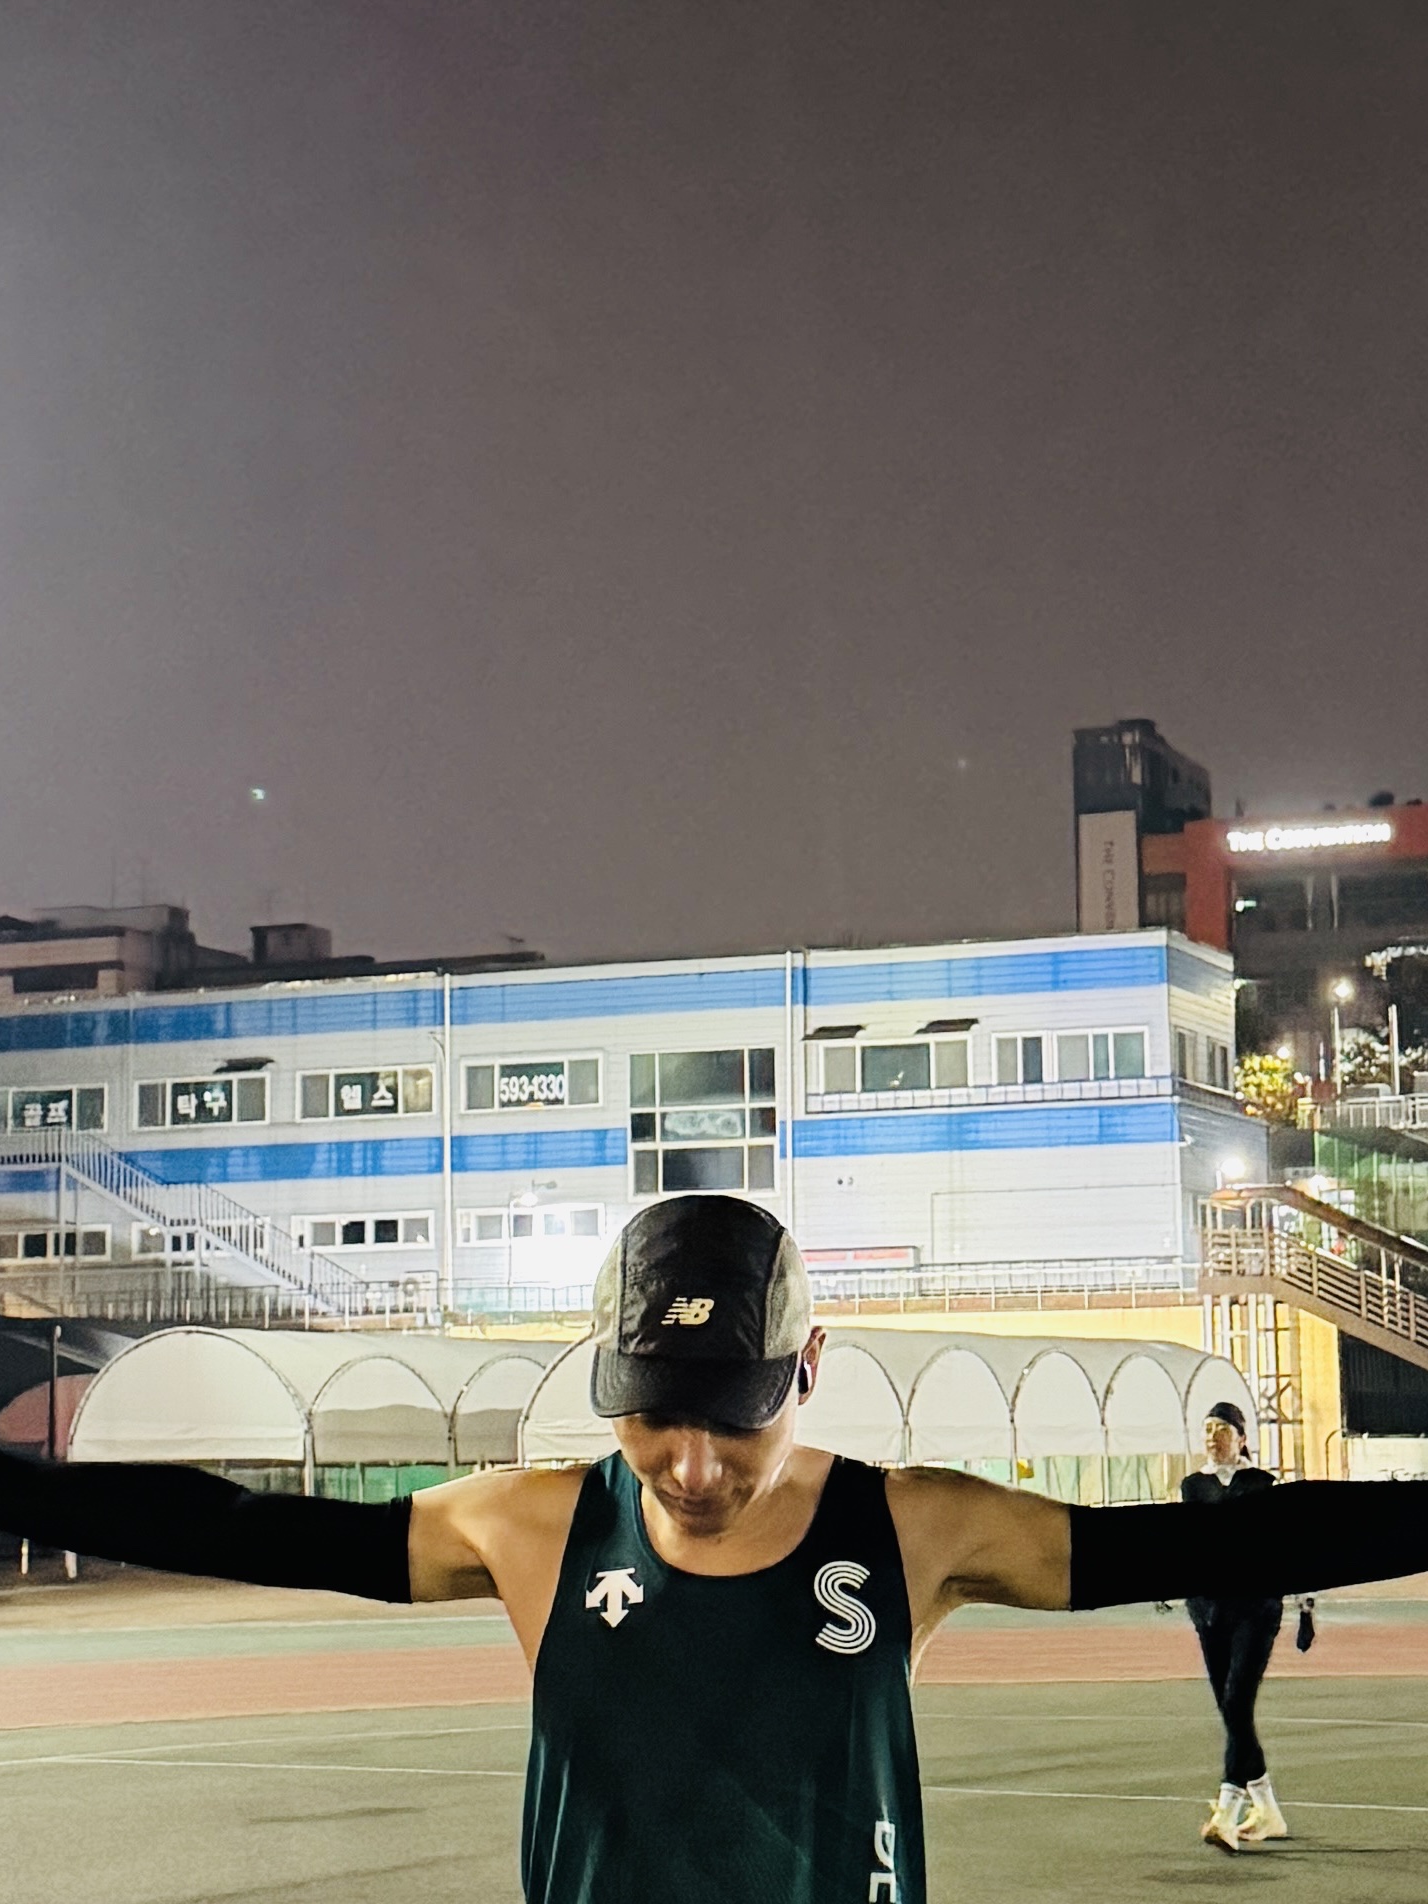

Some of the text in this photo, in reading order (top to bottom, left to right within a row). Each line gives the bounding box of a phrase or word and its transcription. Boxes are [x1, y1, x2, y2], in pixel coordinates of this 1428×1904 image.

[340, 1082, 395, 1110] 헬스
[499, 1074, 565, 1103] 593-1330
[24, 1099, 69, 1127] 골프
[177, 1091, 227, 1119] 탁구
[814, 1561, 876, 1655] S
